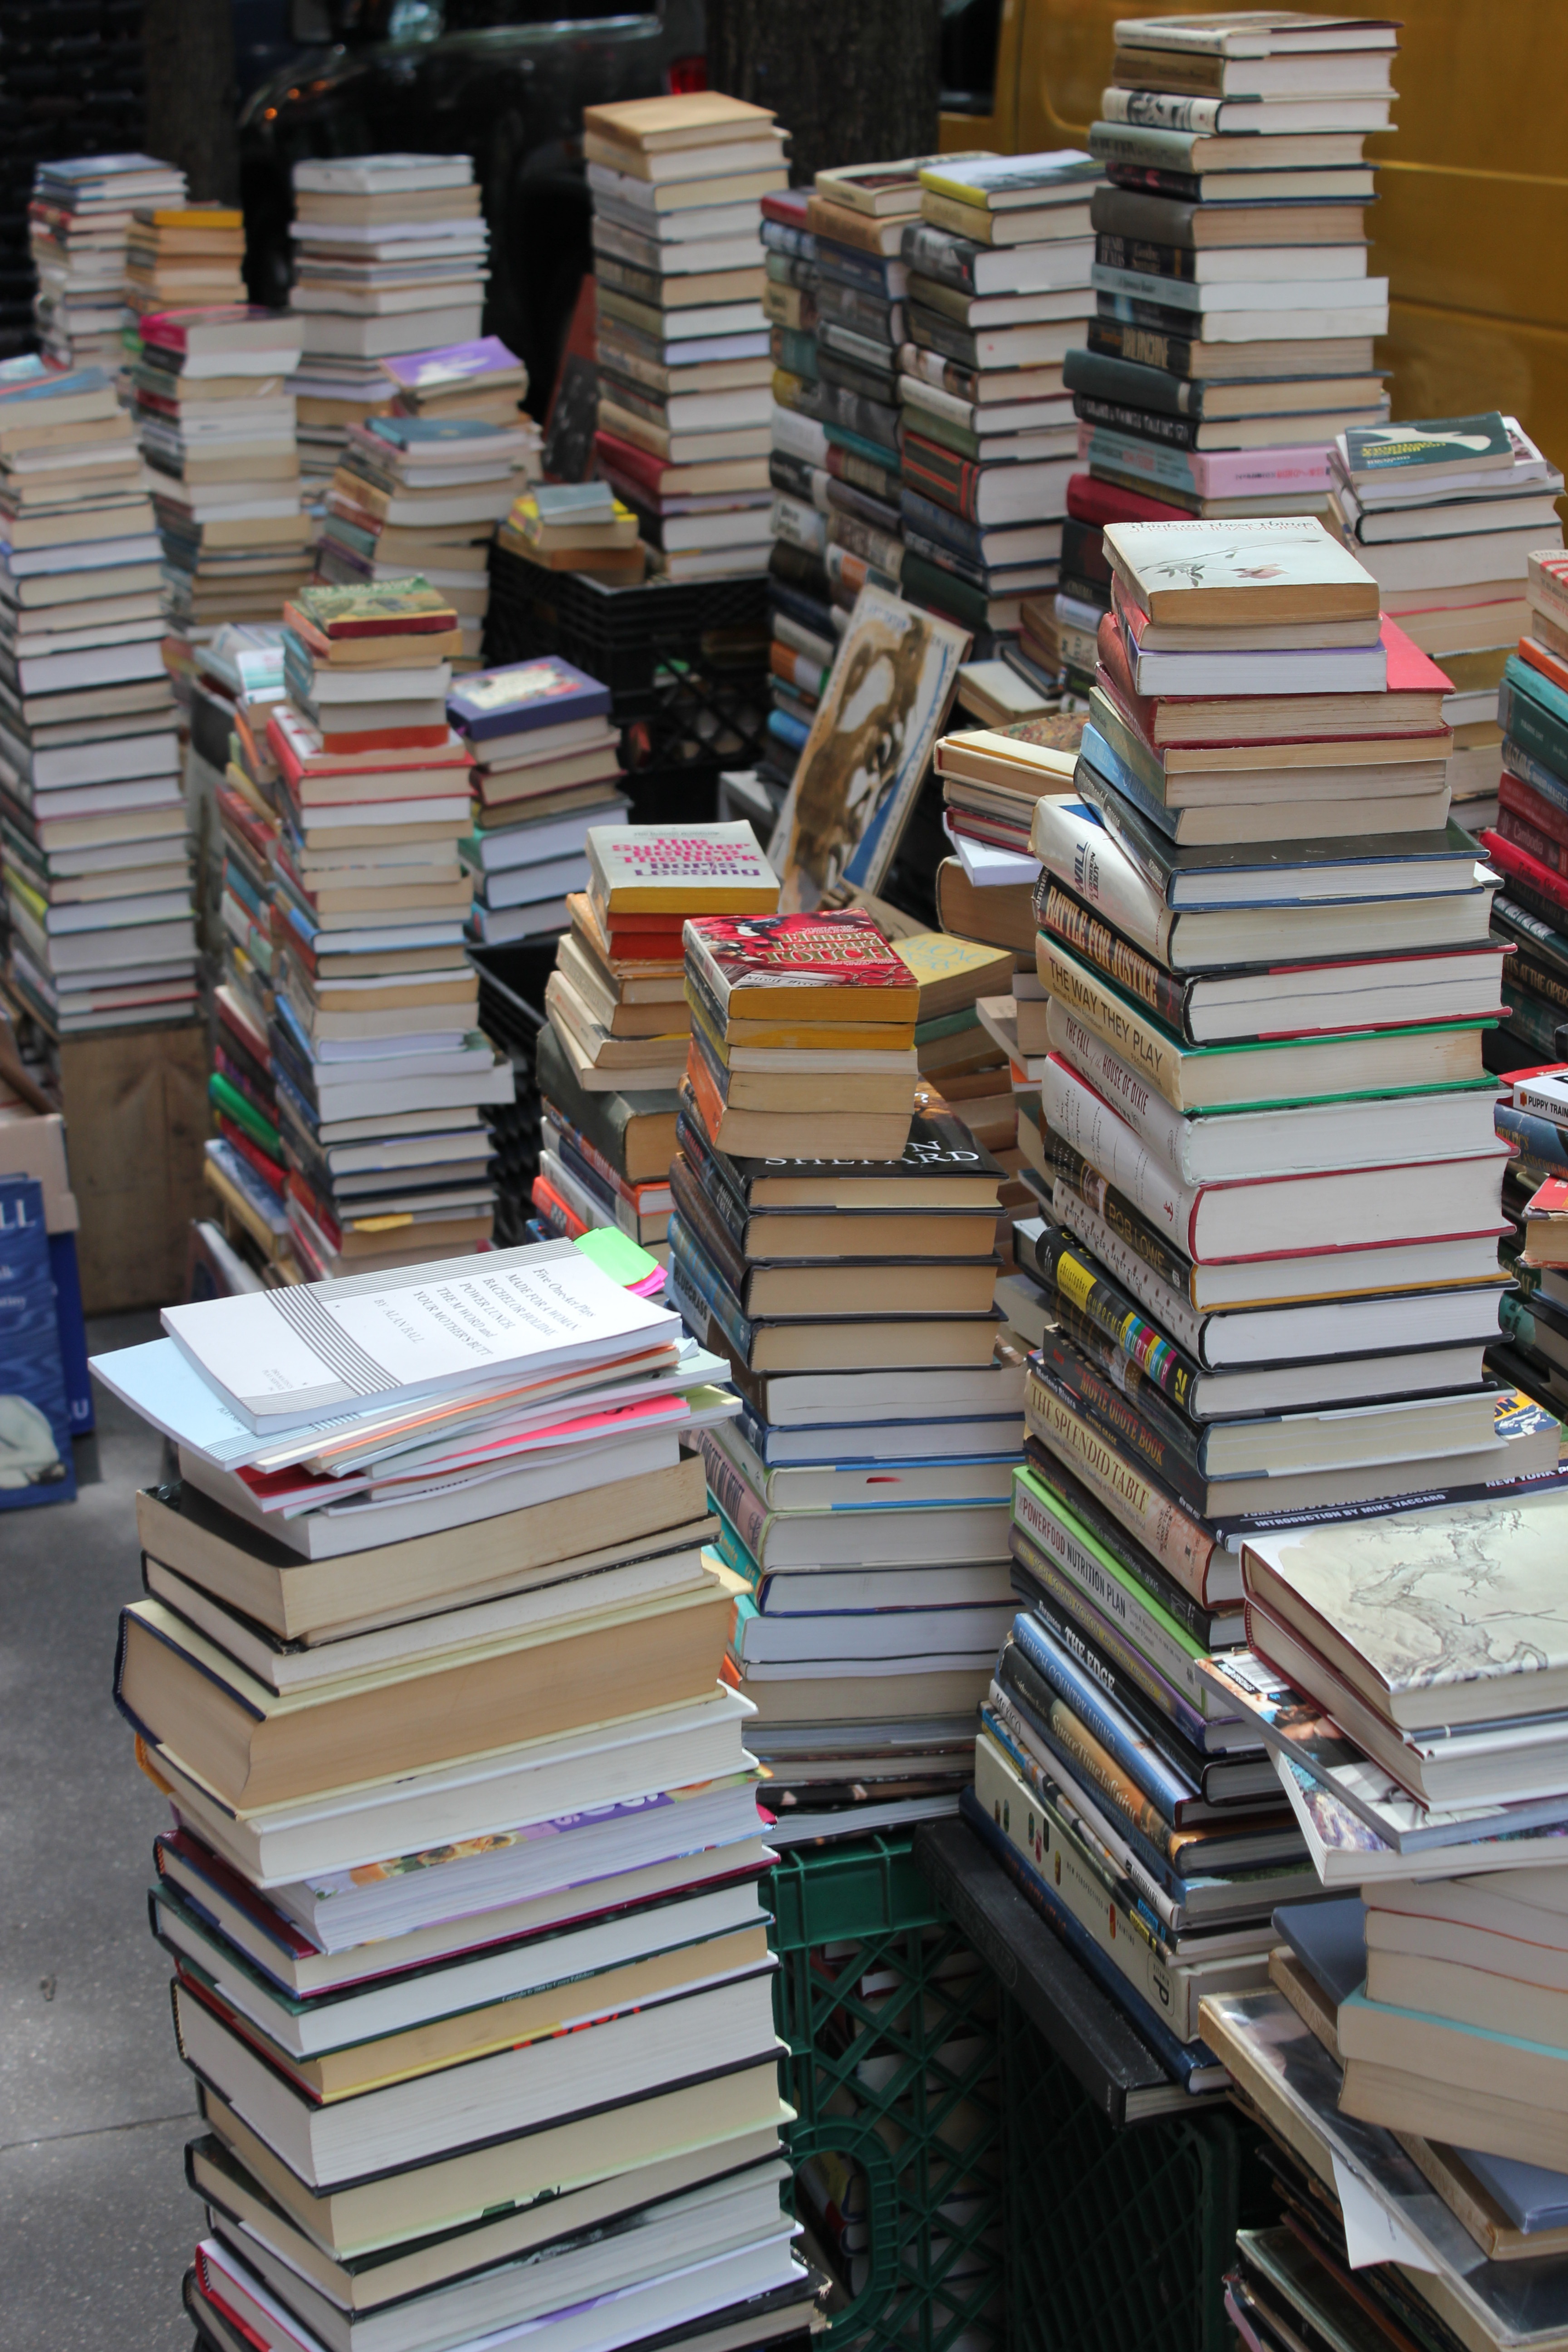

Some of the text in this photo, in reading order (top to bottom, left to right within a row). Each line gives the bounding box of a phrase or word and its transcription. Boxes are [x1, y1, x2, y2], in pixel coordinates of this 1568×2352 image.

[1514, 820, 1544, 855] Cambodia
[1074, 841, 1088, 895] WILL
[757, 946, 897, 964] TOUCH
[770, 937, 887, 951] Leonard
[780, 931, 878, 943] Elmore
[1045, 886, 1159, 1009] BATTLE FOR JUSTICE
[1049, 957, 1163, 1072] THE WAY THEY PLAY
[1066, 1017, 1082, 1044] THE
[1077, 1029, 1090, 1058] FALL
[1089, 1052, 1095, 1063] of
[1102, 1054, 1123, 1090] HOUSE
[1122, 1073, 1137, 1098] OF
[1130, 1079, 1149, 1116] DIXIE
[1528, 1096, 1548, 1111] PUPPY
[1066, 1206, 1143, 1289] WHITE OLEANDER JANET FITCH
[1108, 1202, 1166, 1277] ROB LOWE
[459, 1282, 490, 1308] POWER
[482, 1278, 525, 1314] BACHELOR
[505, 1273, 531, 1294] MADE
[526, 1290, 546, 1308] FOR
[533, 1268, 551, 1284] Five
[673, 1260, 709, 1321] BLUEGRASS
[1059, 1261, 1088, 1295] christopher
[374, 1299, 425, 1344] BY ALAN BALL
[413, 1291, 440, 1315] YOUR
[436, 1287, 457, 1303] THE
[459, 1308, 485, 1331] WORD
[1088, 1294, 1169, 1380] SUPREME COURTSHIP
[1036, 1366, 1076, 1410] Mariano Rivera
[1080, 1374, 1110, 1413] MOVIE
[1109, 1399, 1139, 1441] QUOTE
[1138, 1426, 1166, 1466] BOOK
[1031, 1383, 1054, 1422] THE
[1054, 1407, 1111, 1476] SPLENDID
[1112, 1460, 1150, 1514] TABLE
[1486, 1476, 1516, 1489] NEW
[1254, 1510, 1342, 1528] INTRODUCTION
[1342, 1508, 1358, 1517] BY
[1360, 1502, 1392, 1514] MIKE
[1392, 1494, 1446, 1509] VACCARO
[1023, 1497, 1065, 1556] POWERFOOD
[1067, 1542, 1105, 1597] NUTRITION
[1107, 1583, 1126, 1619] PLAN
[1033, 1556, 1050, 1583] SIGHT
[1051, 1574, 1073, 1608] SOUND
[1074, 1602, 1100, 1636] MOTION
[1064, 1626, 1085, 1656] THE
[1087, 1650, 1116, 1693] EDGE
[1019, 1628, 1116, 1752] FRENCH COUNTRY LIVING
[995, 1693, 1022, 1735] MEXICO
[1067, 1861, 1075, 1875] NEW
[1076, 1870, 1103, 1909] PERSPECTIVES
[1117, 1918, 1135, 1946] PAINTING
